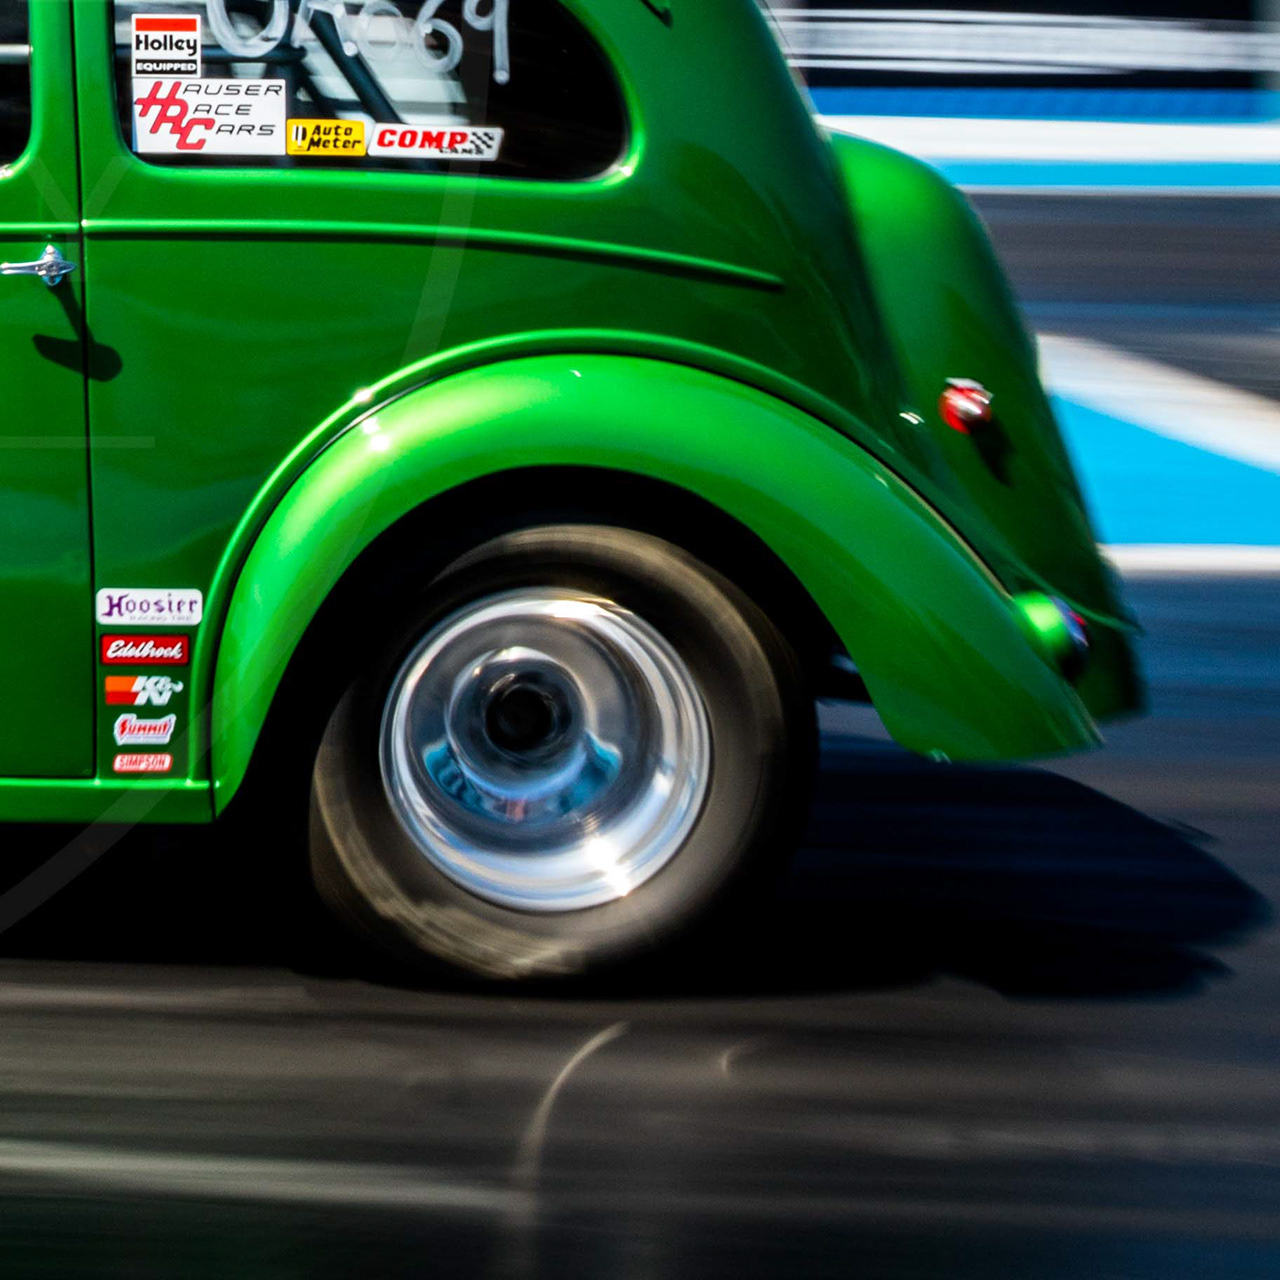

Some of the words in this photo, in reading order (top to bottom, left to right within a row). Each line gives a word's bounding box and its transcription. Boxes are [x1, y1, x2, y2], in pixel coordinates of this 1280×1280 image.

[135, 34, 197, 57] Holley
[136, 62, 197, 72] EQUIPPED
[312, 125, 353, 136] Auto
[377, 129, 468, 149] COMP
[307, 137, 361, 151] Meter
[101, 592, 198, 617] Hoosier
[106, 639, 183, 659] Edelbrock
[120, 755, 166, 768] SIMPSON
